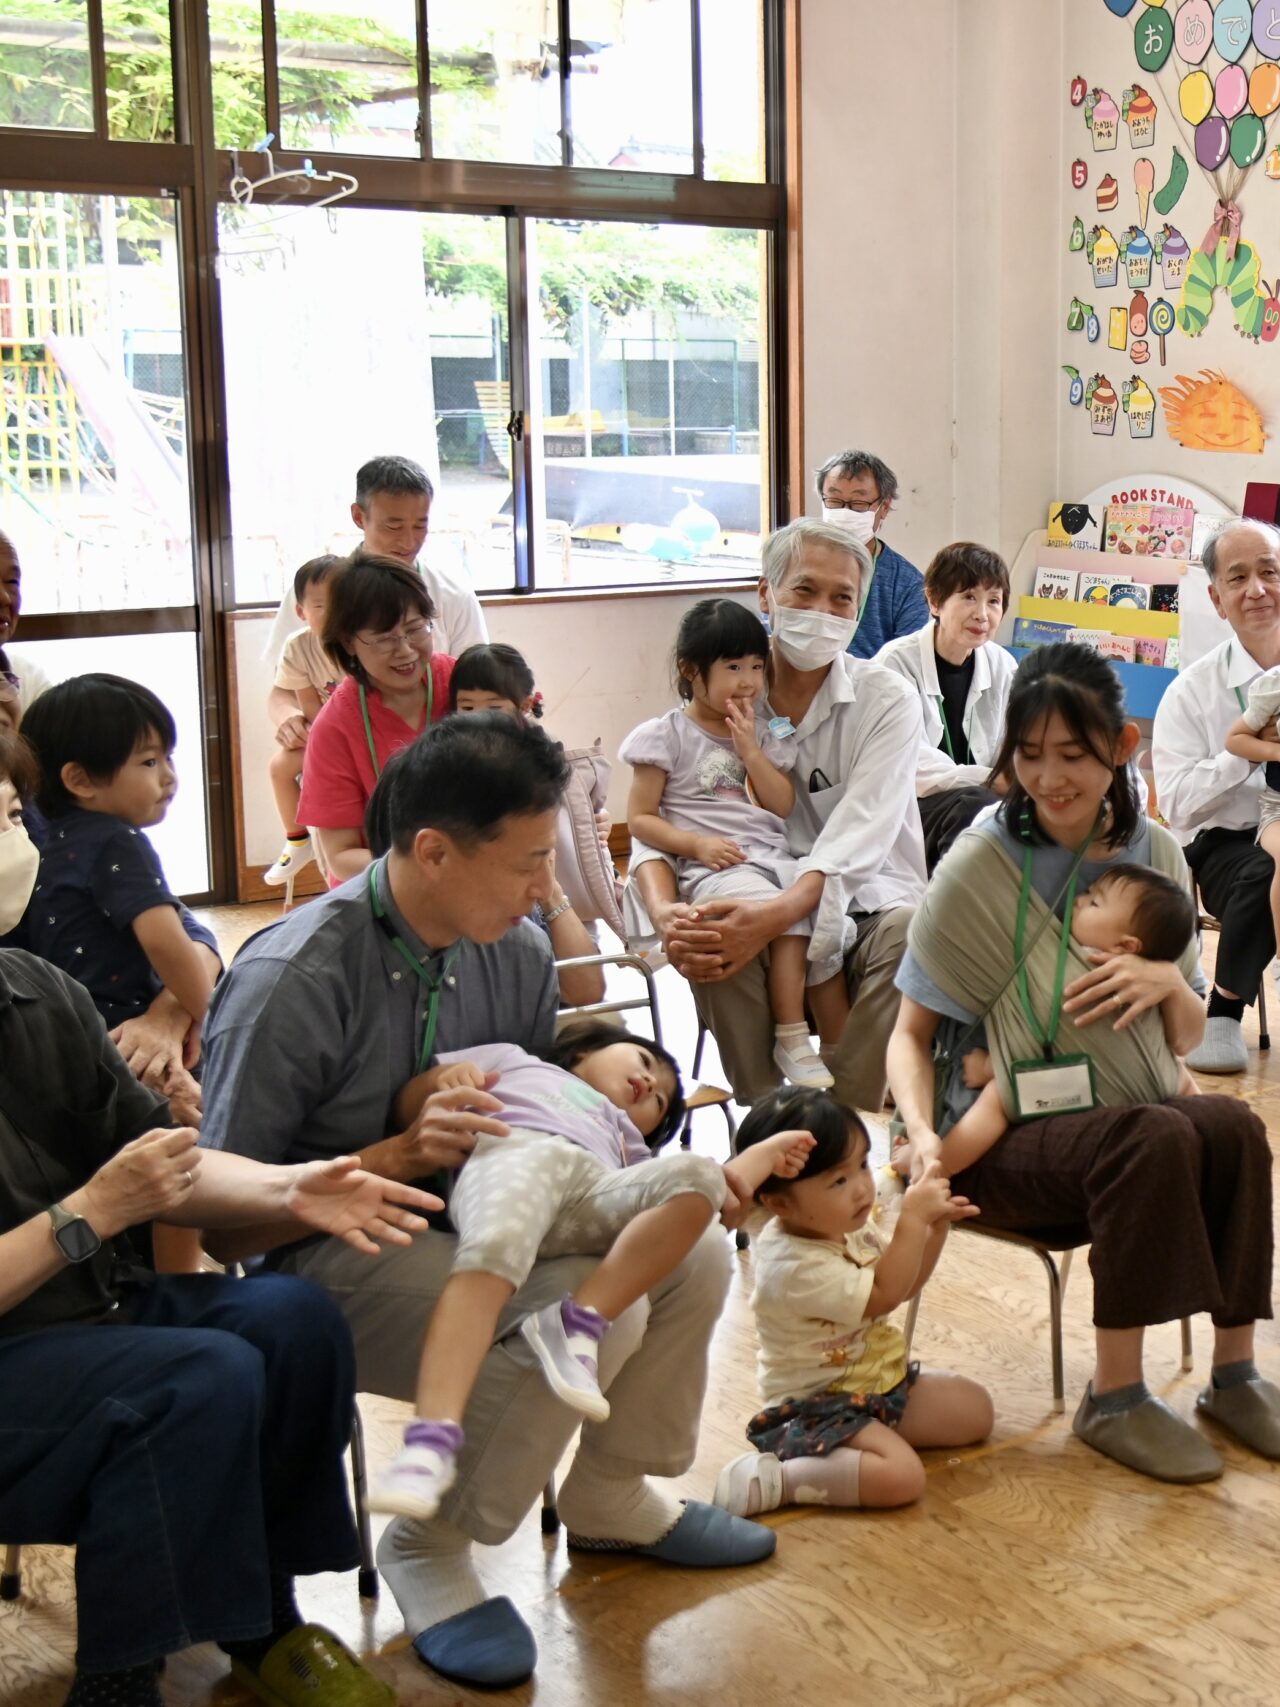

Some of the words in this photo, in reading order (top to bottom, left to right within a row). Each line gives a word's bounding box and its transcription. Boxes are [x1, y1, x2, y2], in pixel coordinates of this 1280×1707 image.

[1072, 84, 1083, 103] 4
[1074, 166, 1084, 186] 5
[1073, 227, 1082, 247] 6
[1096, 256, 1114, 266] おがわ
[1167, 259, 1184, 268] おくの
[1071, 307, 1080, 327] 7
[1088, 319, 1096, 338] 8
[1071, 383, 1081, 400] 9
[1111, 488, 1148, 504] BOOK
[1151, 489, 1195, 510] STAND
